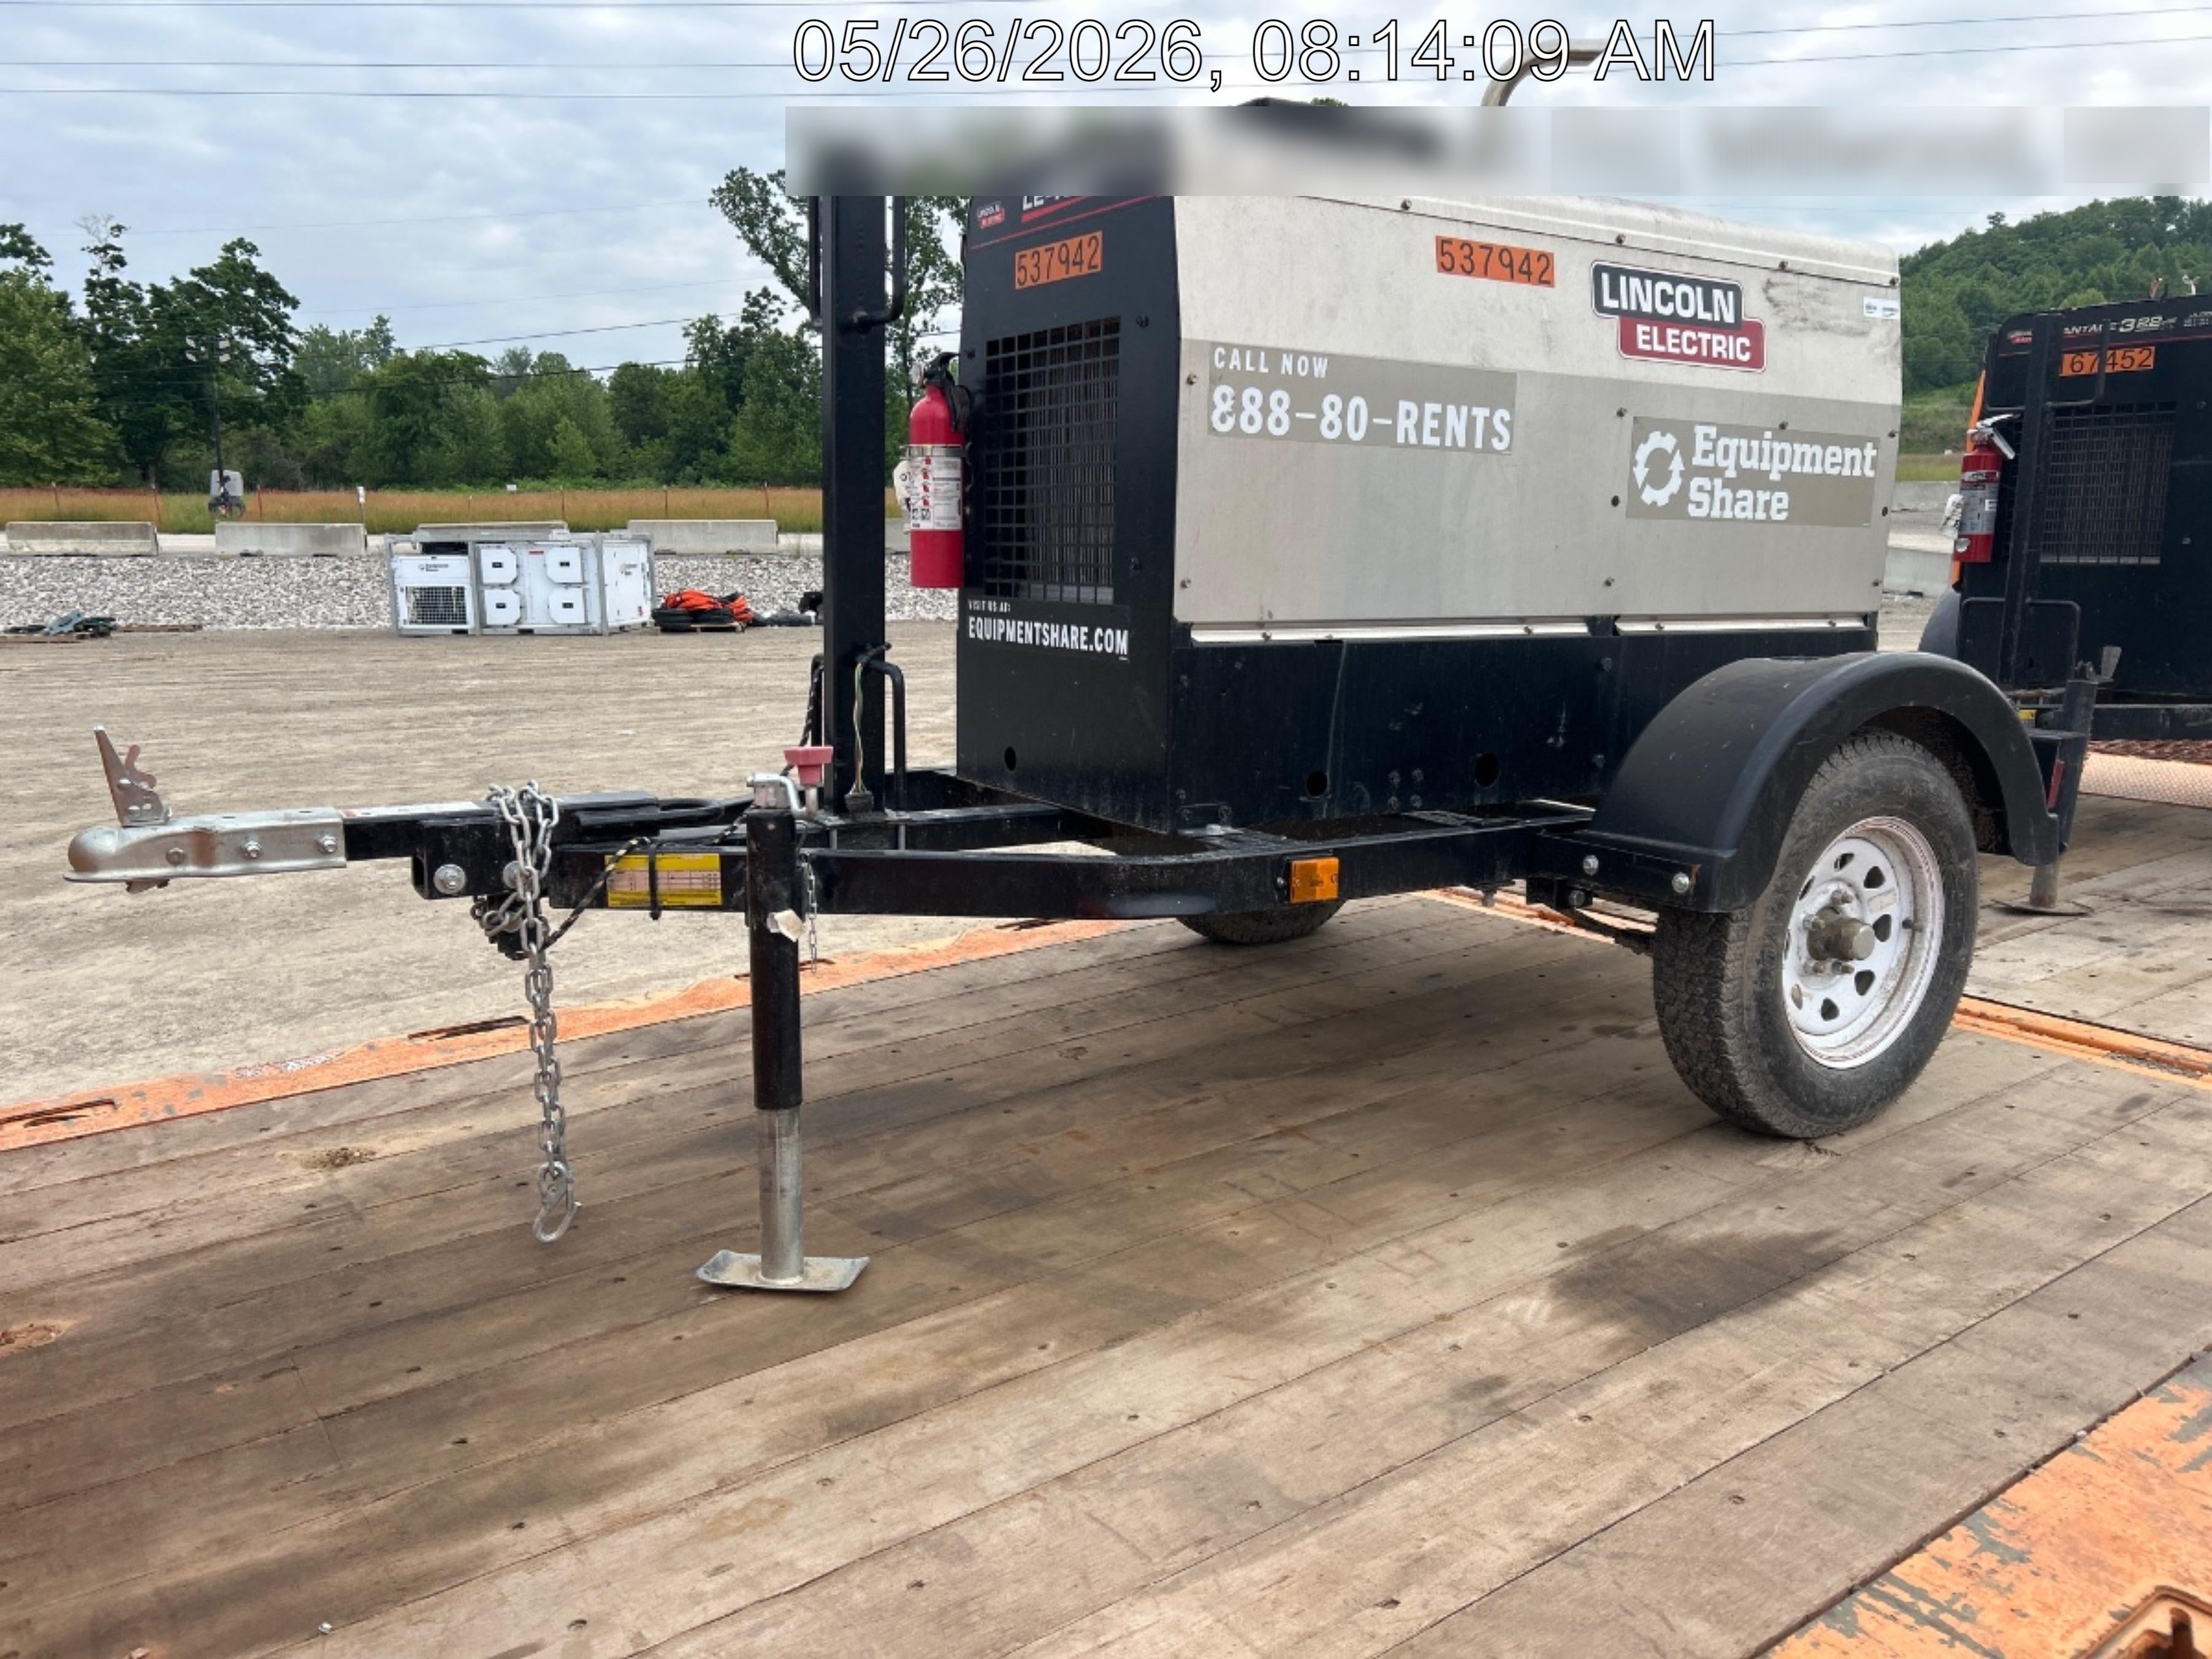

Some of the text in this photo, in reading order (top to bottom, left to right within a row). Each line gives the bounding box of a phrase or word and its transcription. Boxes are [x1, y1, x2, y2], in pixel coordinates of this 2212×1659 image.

[1017, 235, 1100, 286] 537942
[1440, 239, 1551, 286] 537942
[1601, 272, 1736, 324] LINCOLN
[1214, 347, 1329, 378] CALL NOW
[1636, 324, 1751, 361] ELECTRIC
[1210, 384, 1512, 452] 888-80-RENTS
[1692, 424, 1877, 482] Equipment
[1687, 477, 1789, 521] Share
[968, 616, 1129, 656] EQUIPMENTSHARE.COM
